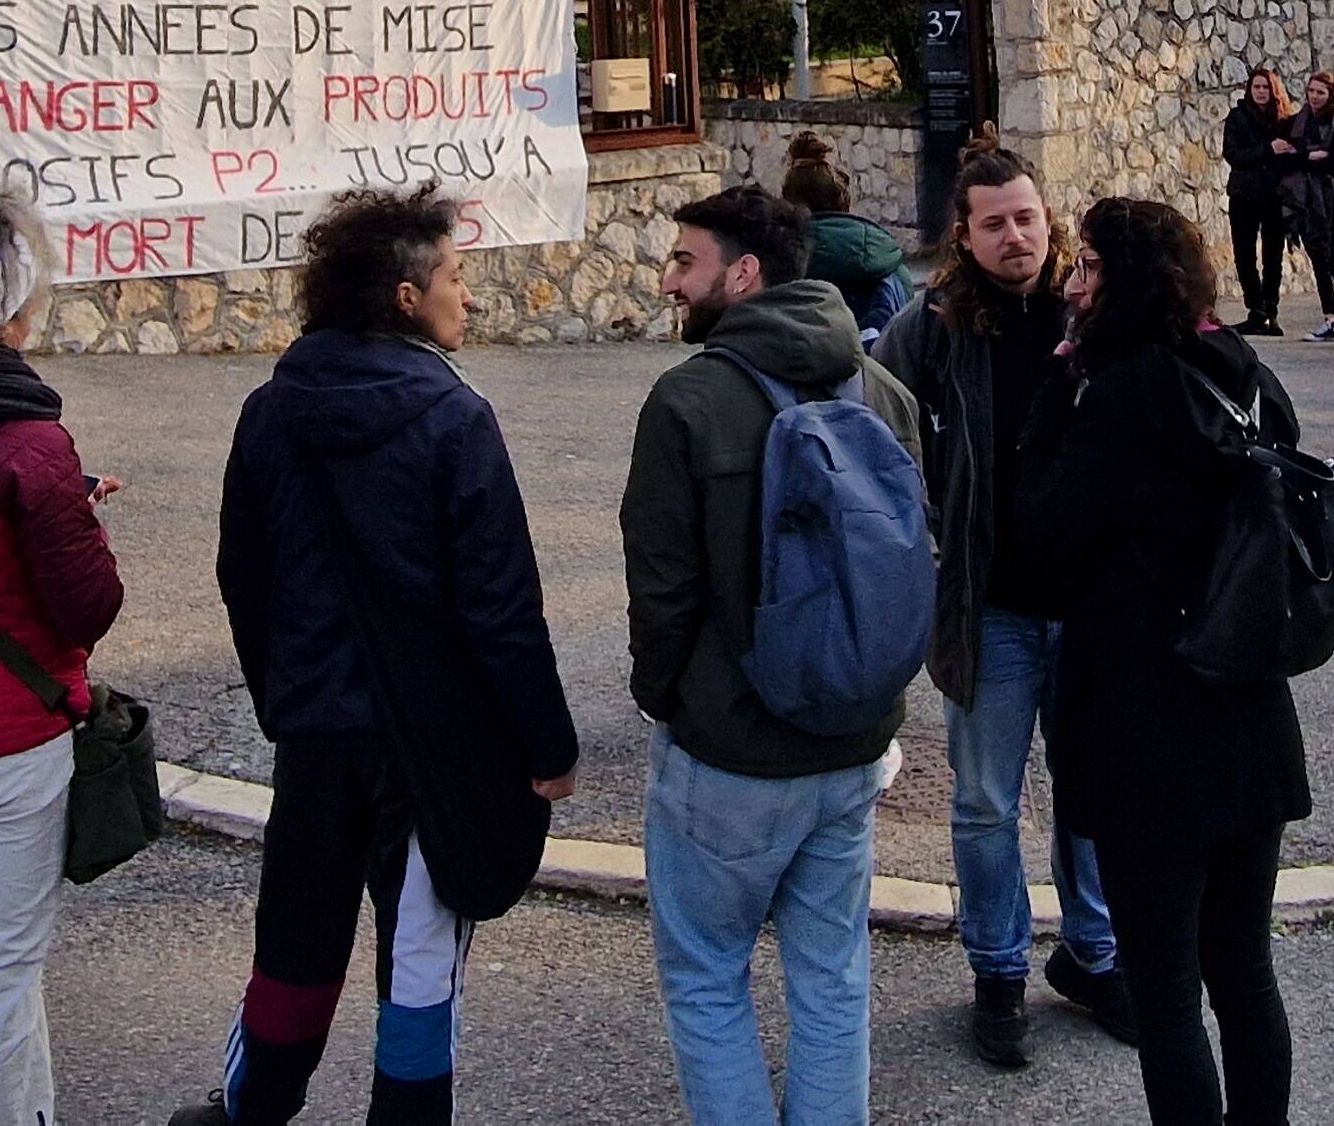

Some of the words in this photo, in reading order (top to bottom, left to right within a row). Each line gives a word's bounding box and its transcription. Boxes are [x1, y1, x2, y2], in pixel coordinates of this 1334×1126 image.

[58, 4, 260, 56] ANNEES
[293, 4, 354, 56] DE
[382, 3, 495, 54] MISE
[927, 10, 962, 38] 37
[195, 77, 292, 131] AUX
[322, 69, 549, 124] PRODUITS
[67, 216, 206, 276] MORT
